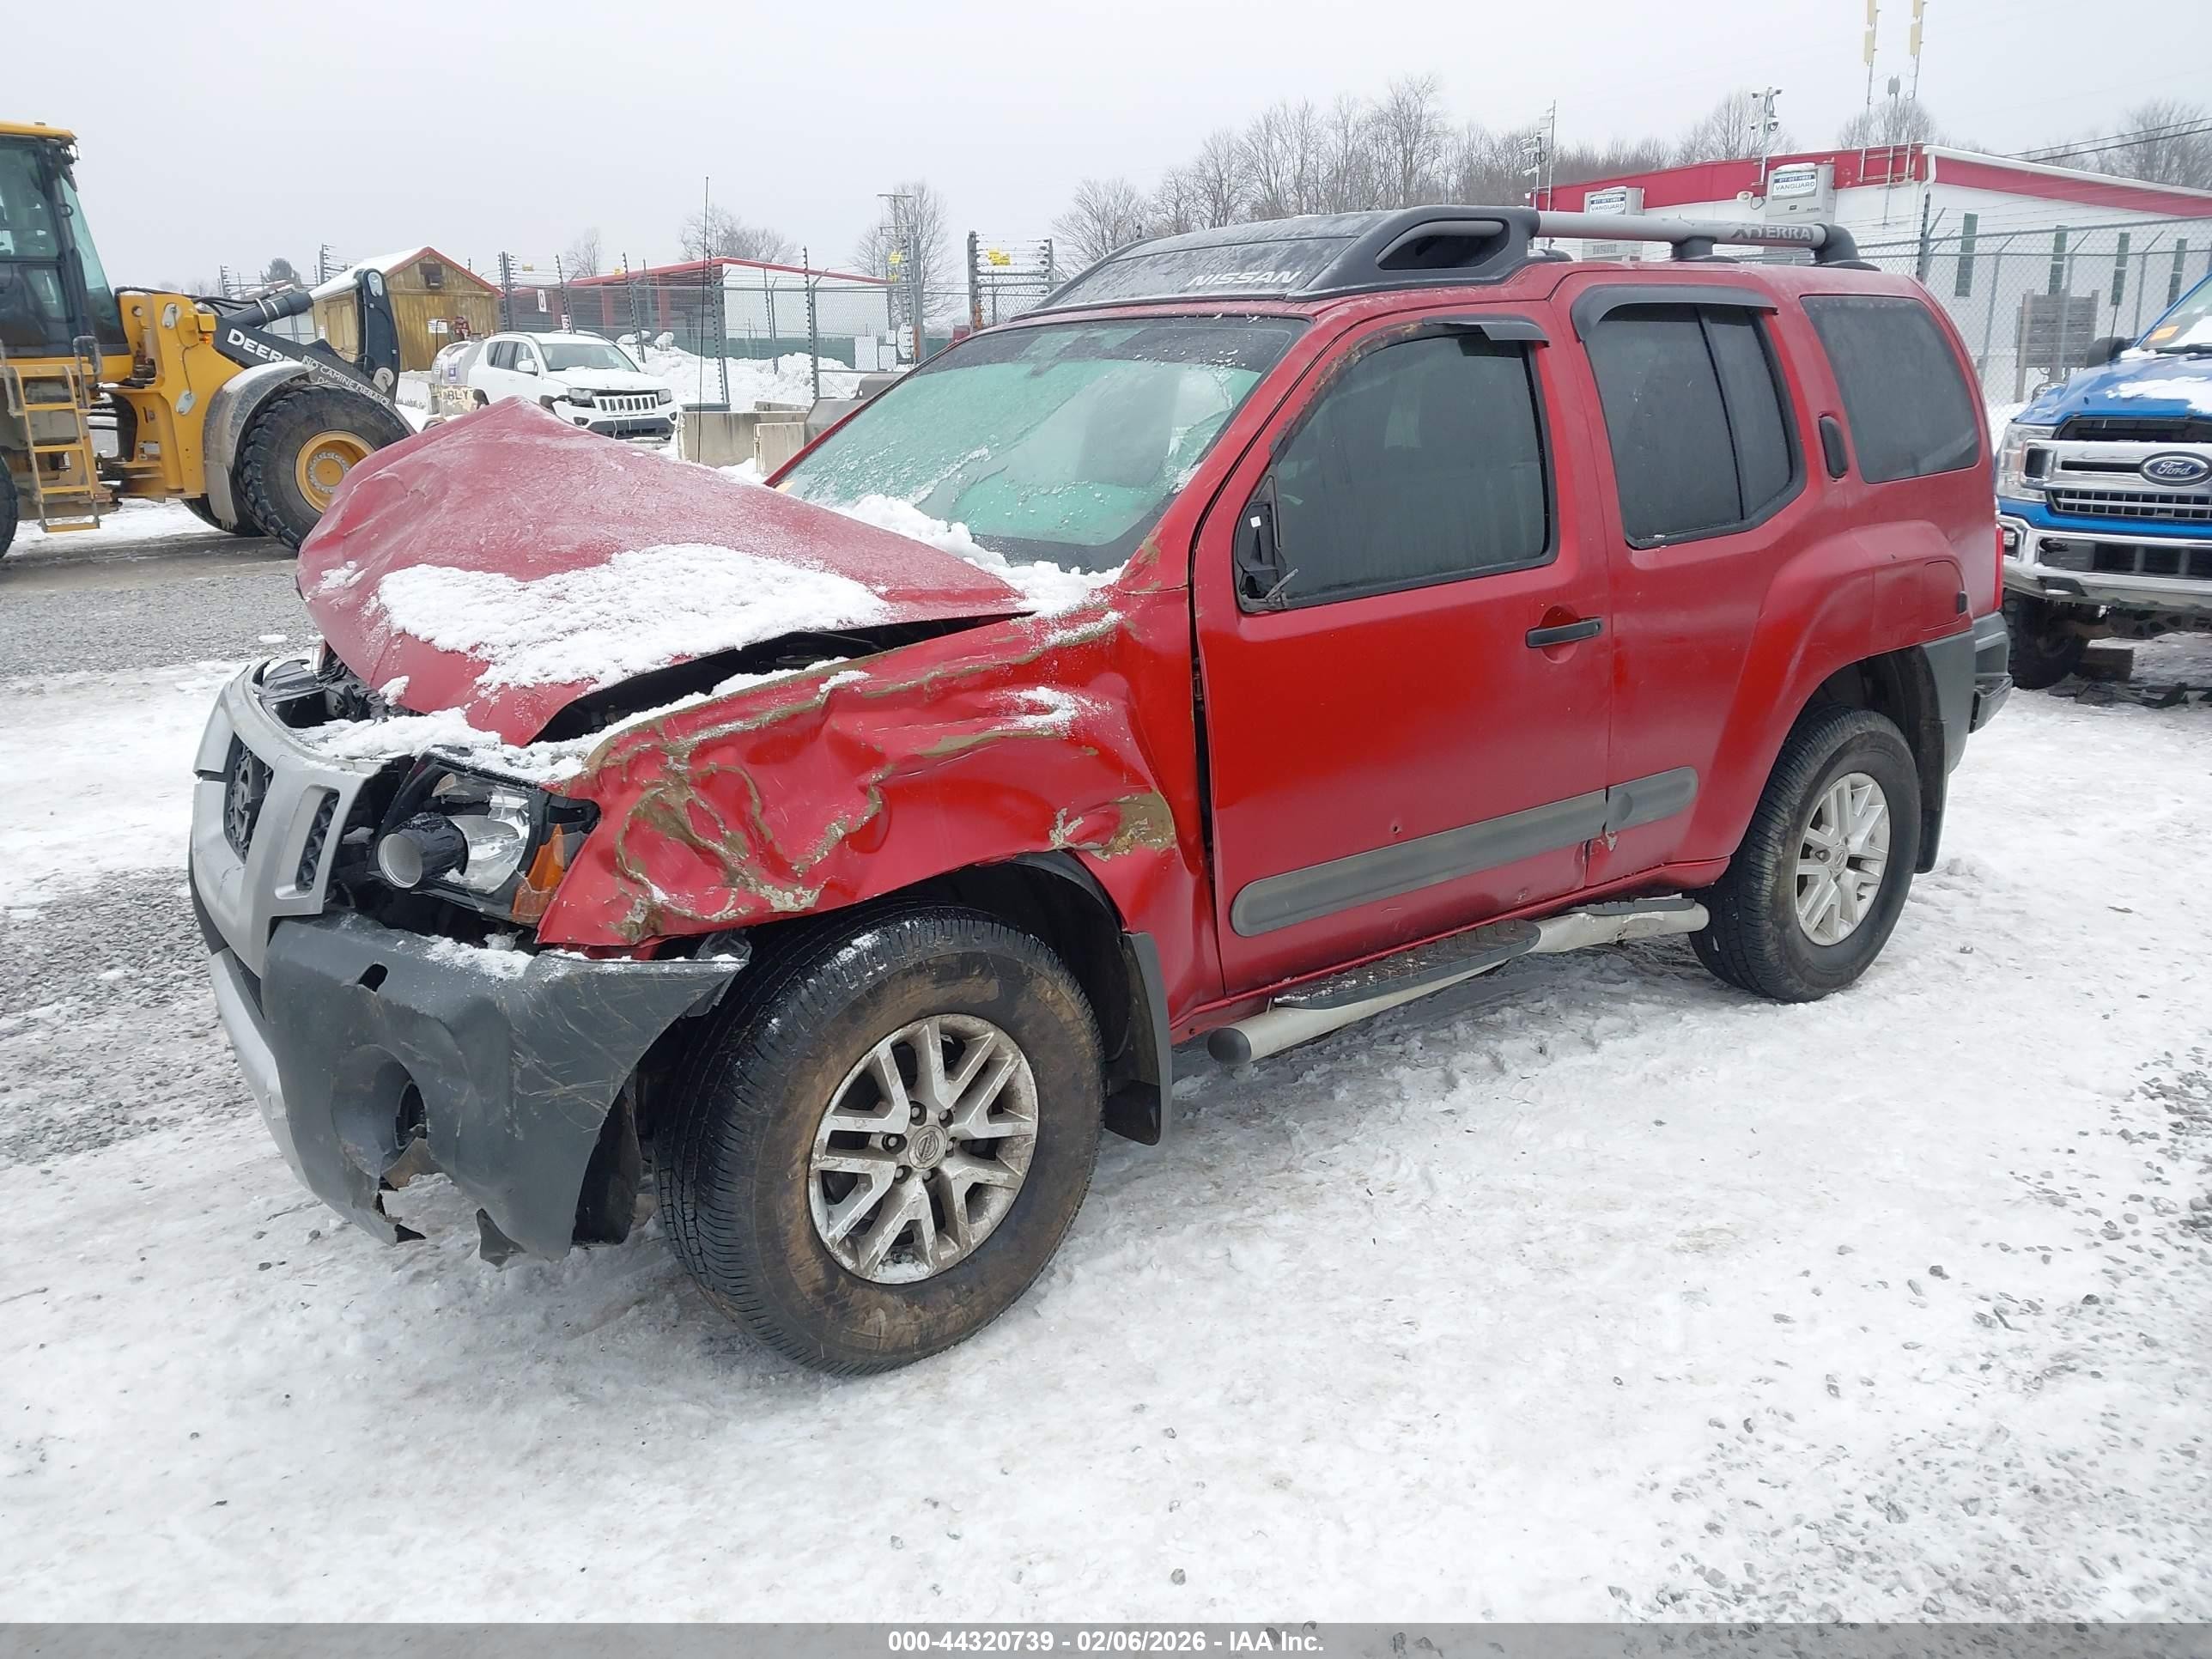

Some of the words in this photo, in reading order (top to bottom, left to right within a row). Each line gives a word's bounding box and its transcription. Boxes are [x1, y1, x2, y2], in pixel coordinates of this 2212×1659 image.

[1775, 181, 1815, 191] VANGUARD
[1184, 270, 1302, 287] NISSAN
[302, 356, 319, 369] NO
[320, 367, 355, 387] CAMINE
[2156, 460, 2193, 475] Ford
